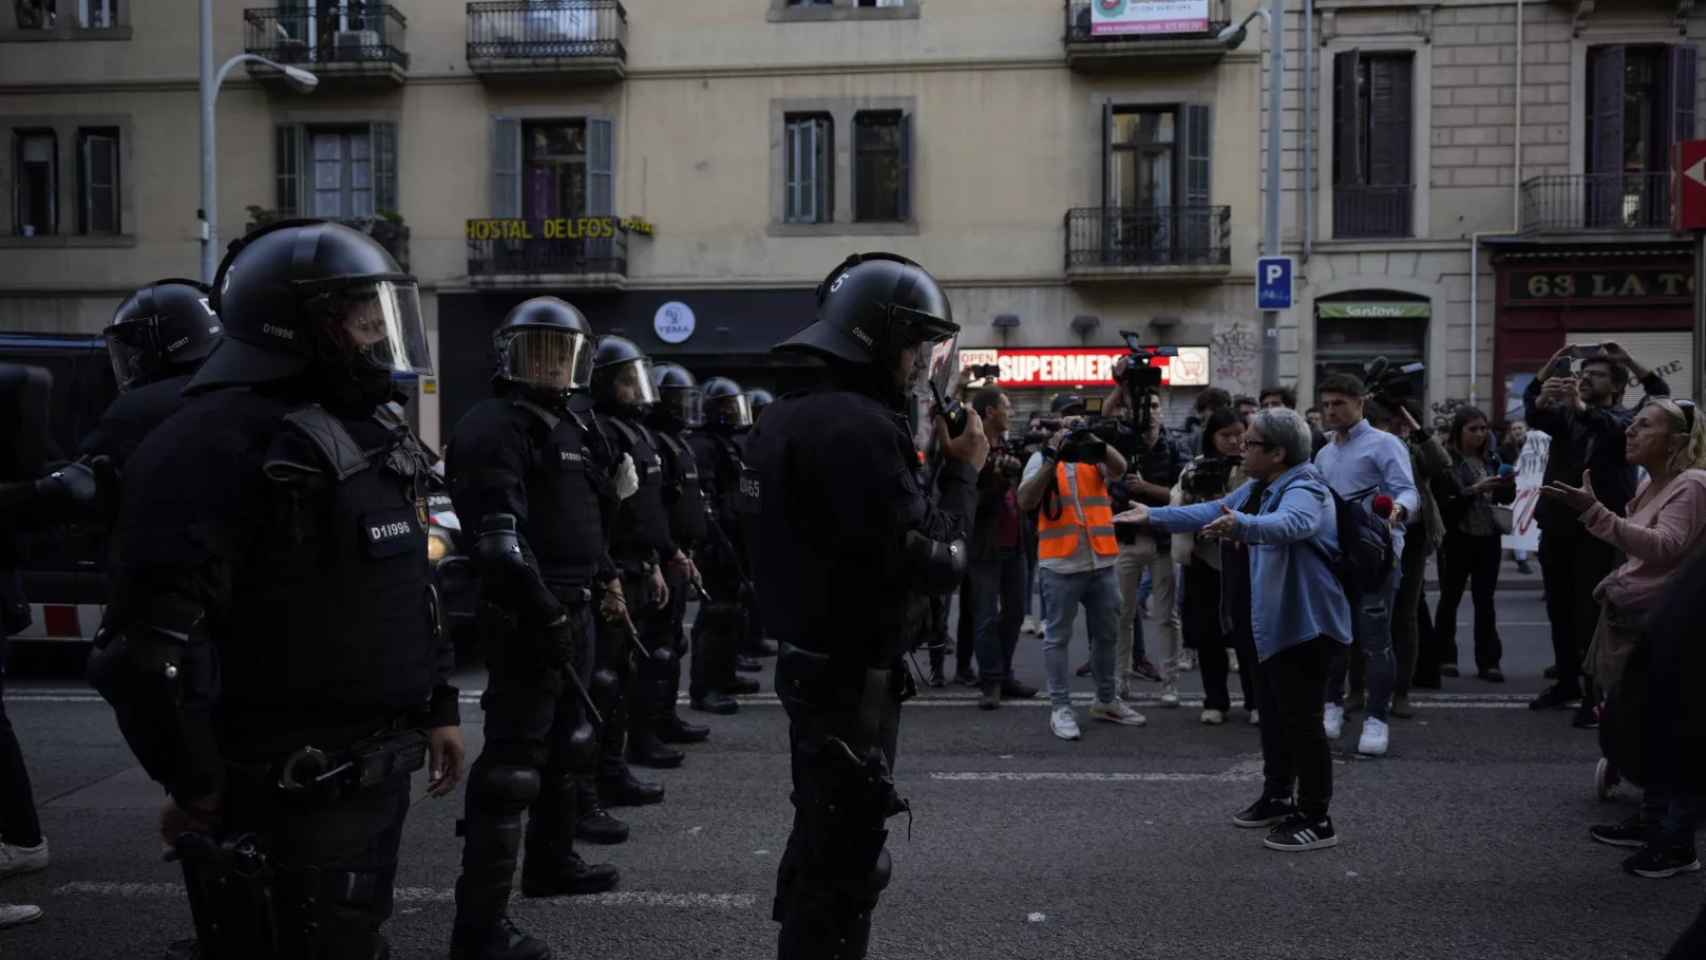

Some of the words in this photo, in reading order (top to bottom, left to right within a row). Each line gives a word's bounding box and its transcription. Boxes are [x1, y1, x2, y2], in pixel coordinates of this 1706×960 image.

[465, 218, 533, 240] HOSTAL
[544, 217, 614, 240] DELFOS
[1266, 264, 1283, 285] P
[1527, 273, 1574, 297] 63
[1591, 272, 1646, 297] LA
[961, 353, 994, 364] OPEN
